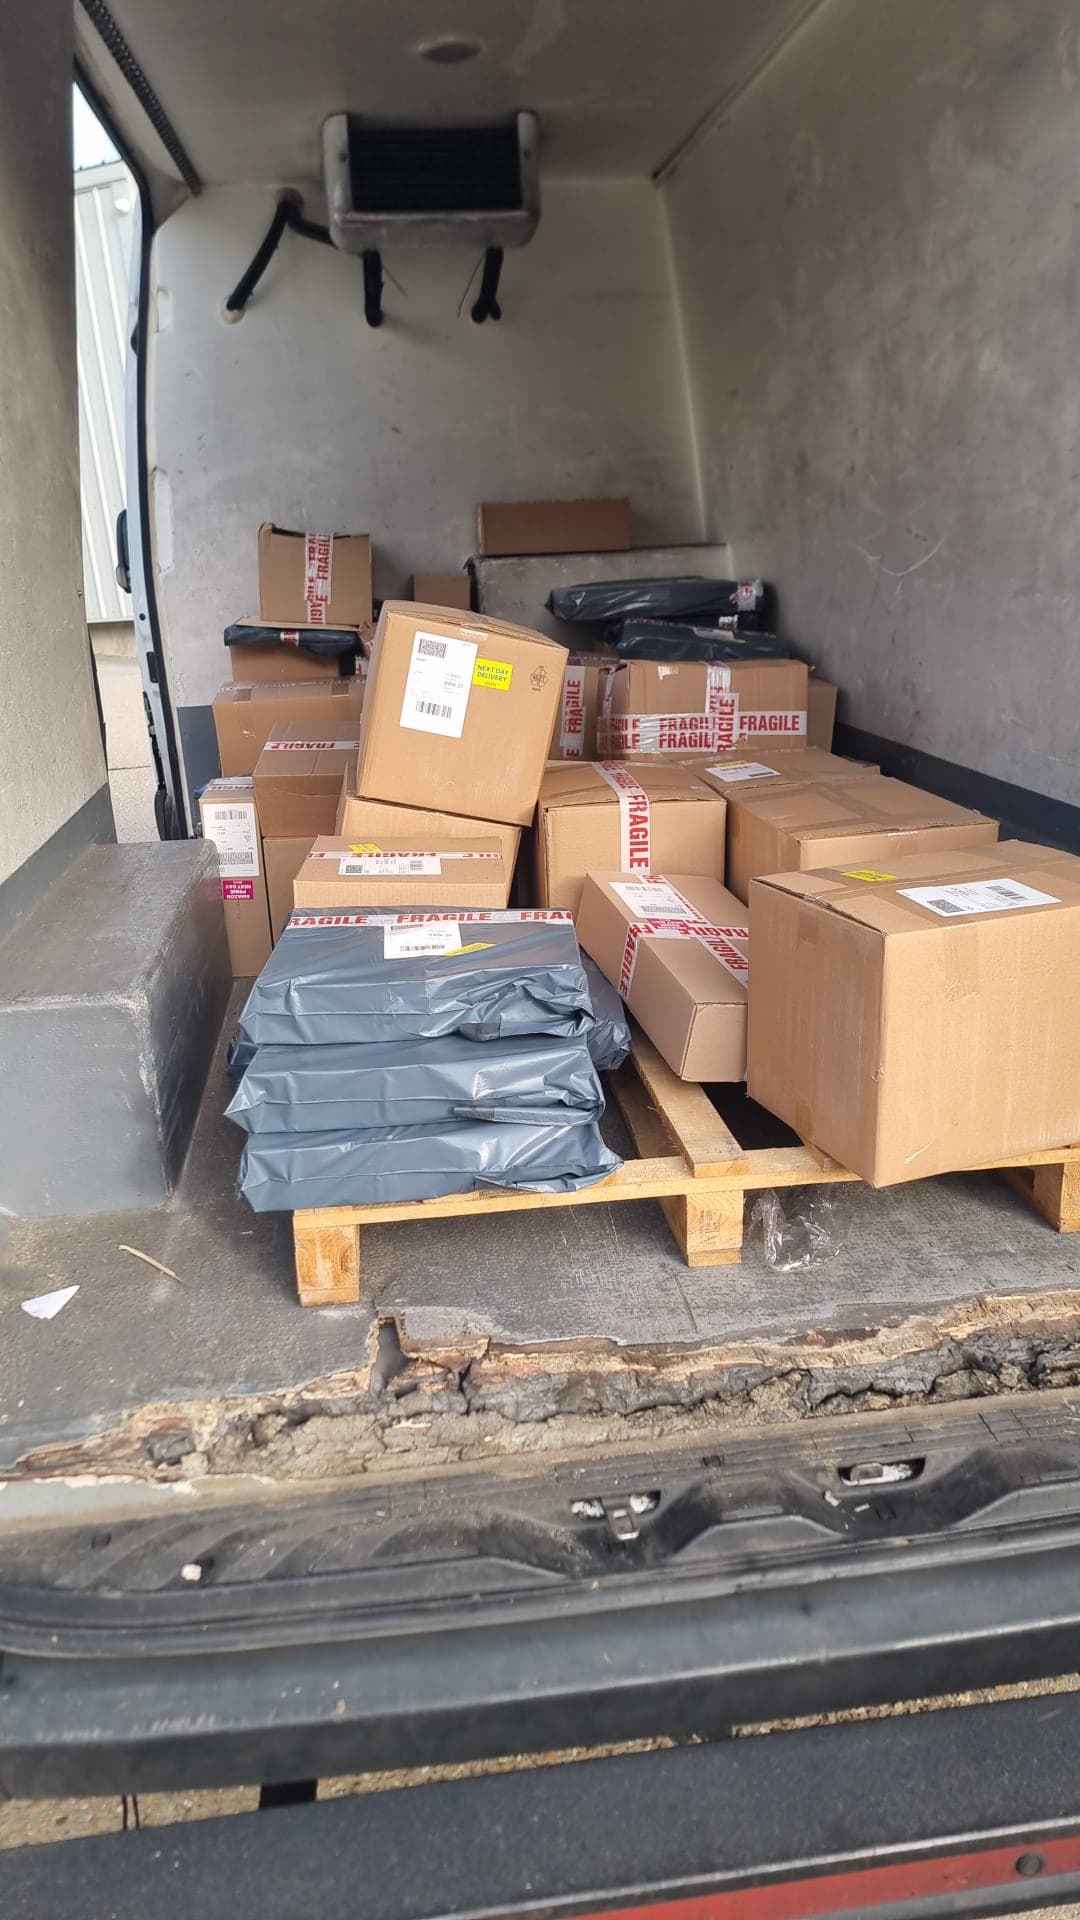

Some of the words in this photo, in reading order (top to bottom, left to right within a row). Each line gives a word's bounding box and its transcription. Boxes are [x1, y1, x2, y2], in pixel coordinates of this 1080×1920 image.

[477, 664, 495, 674] NEXT
[495, 667, 509, 675] DAY
[477, 671, 507, 682] DELIVERY
[566, 680, 583, 733] FRAGILE
[717, 698, 735, 752] RAGILE
[739, 715, 800, 731] FRAGILE
[627, 794, 649, 869] FRAGILE
[289, 916, 368, 926] RAGILE
[396, 912, 492, 923] FRAGILE
[706, 940, 748, 970] FRAGIL
